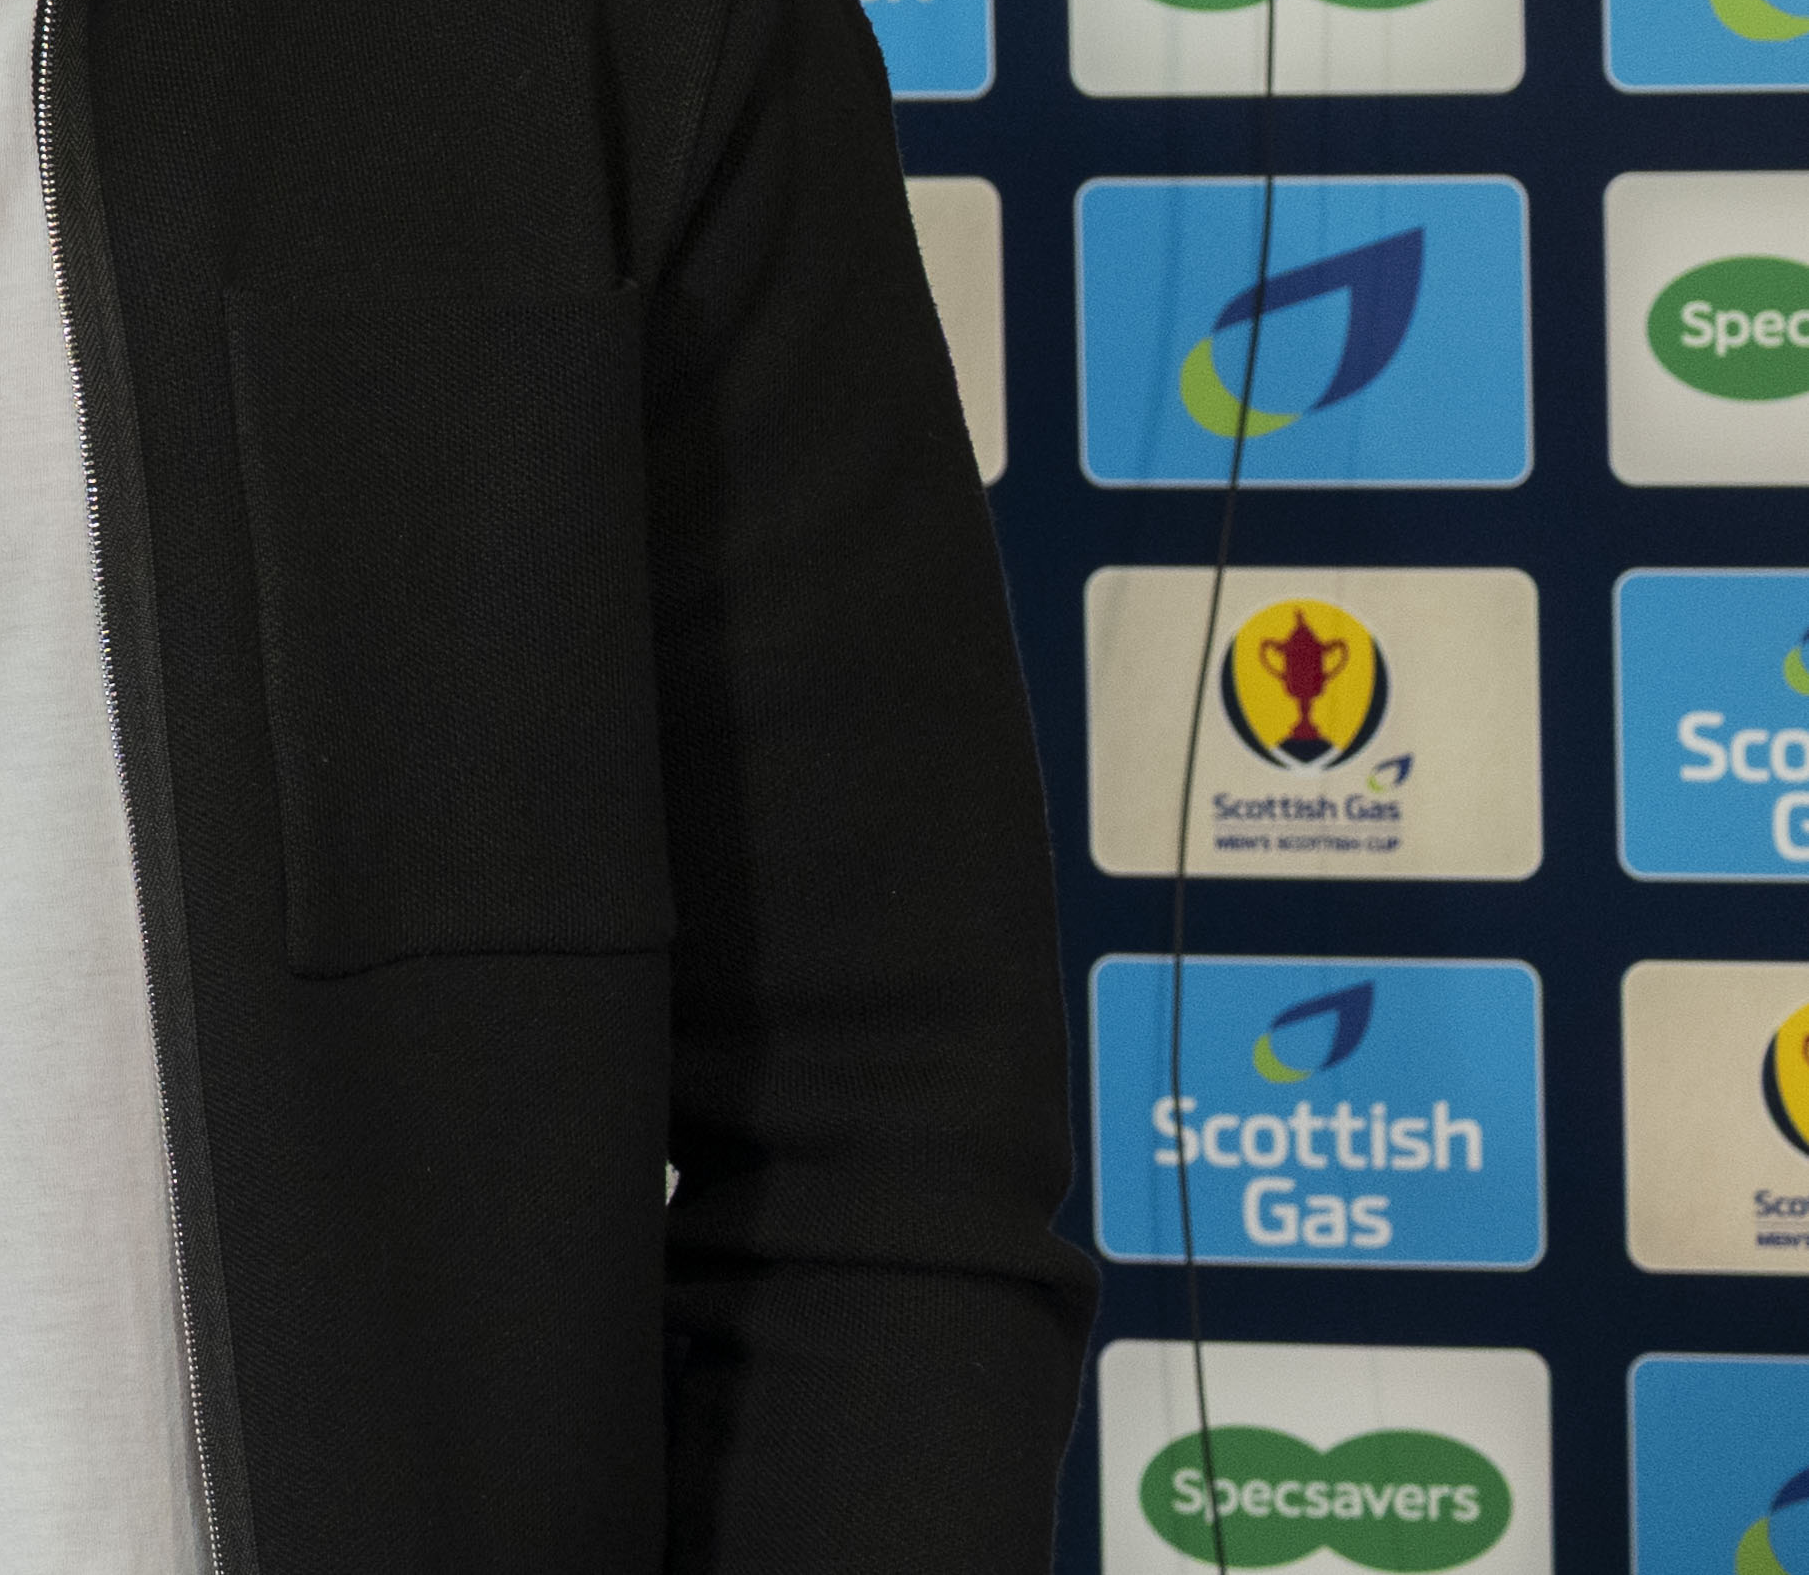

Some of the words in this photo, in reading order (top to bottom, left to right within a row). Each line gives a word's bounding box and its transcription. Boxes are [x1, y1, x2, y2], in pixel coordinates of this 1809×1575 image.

[1212, 793, 1338, 822] Scottish
[1344, 794, 1402, 823] Gas
[1365, 836, 1401, 853] CUP
[1152, 1096, 1483, 1172] Scottish
[1242, 1176, 1393, 1249] Gas
[1172, 1468, 1481, 1523] Specsavers
